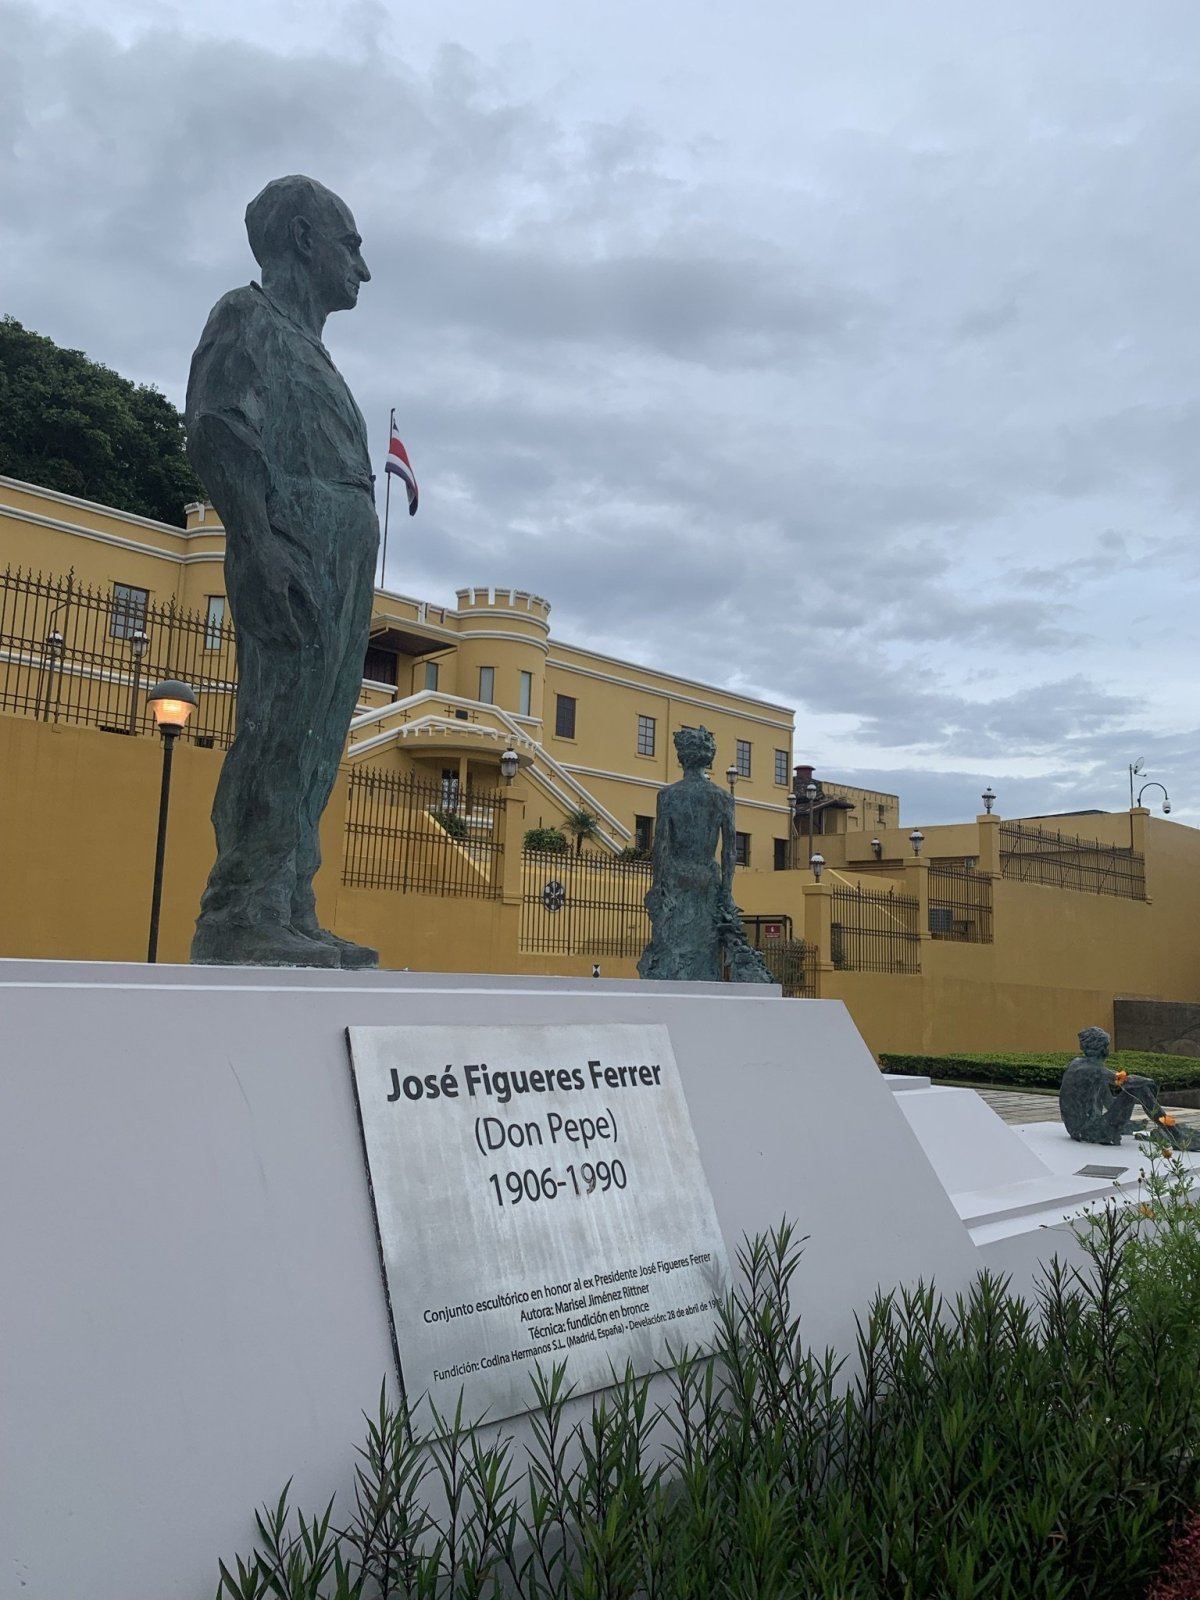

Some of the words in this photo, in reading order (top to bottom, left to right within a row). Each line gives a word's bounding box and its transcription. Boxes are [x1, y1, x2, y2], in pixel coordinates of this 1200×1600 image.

[387, 1064, 459, 1102] José
[464, 1063, 585, 1103] Figueres
[588, 1060, 661, 1089] Ferrer
[475, 1117, 543, 1156] (Don
[547, 1108, 618, 1149] Pepe)
[489, 1159, 627, 1206] 1906-1990
[423, 1304, 474, 1323] Conjunto
[476, 1292, 529, 1312] escultórico
[531, 1289, 543, 1300] en
[544, 1282, 572, 1297] honor
[574, 1278, 582, 1291] al
[583, 1279, 594, 1289] ex
[594, 1269, 638, 1286] Presidente
[640, 1262, 656, 1277] José
[657, 1258, 689, 1273] Figueres
[689, 1253, 711, 1265] Ferrer
[520, 1306, 554, 1322] Autora:
[555, 1296, 587, 1314] Marisel
[588, 1291, 622, 1307] Jiménez
[622, 1284, 649, 1298] Rittner
[433, 1361, 480, 1381] Fundición:
[480, 1354, 509, 1369] Codina
[511, 1343, 551, 1361] Hermanos
[566, 1330, 597, 1348] (Madrid,
[597, 1324, 624, 1339] España)
[628, 1314, 667, 1331] Develación:
[667, 1309, 675, 1320] 28
[676, 1308, 684, 1318] de
[685, 1303, 699, 1316] abril
[700, 1301, 708, 1311] de
[528, 1323, 566, 1340] Técnica:
[566, 1311, 608, 1330] fundición
[609, 1309, 620, 1320] en
[620, 1302, 649, 1317] bronce
